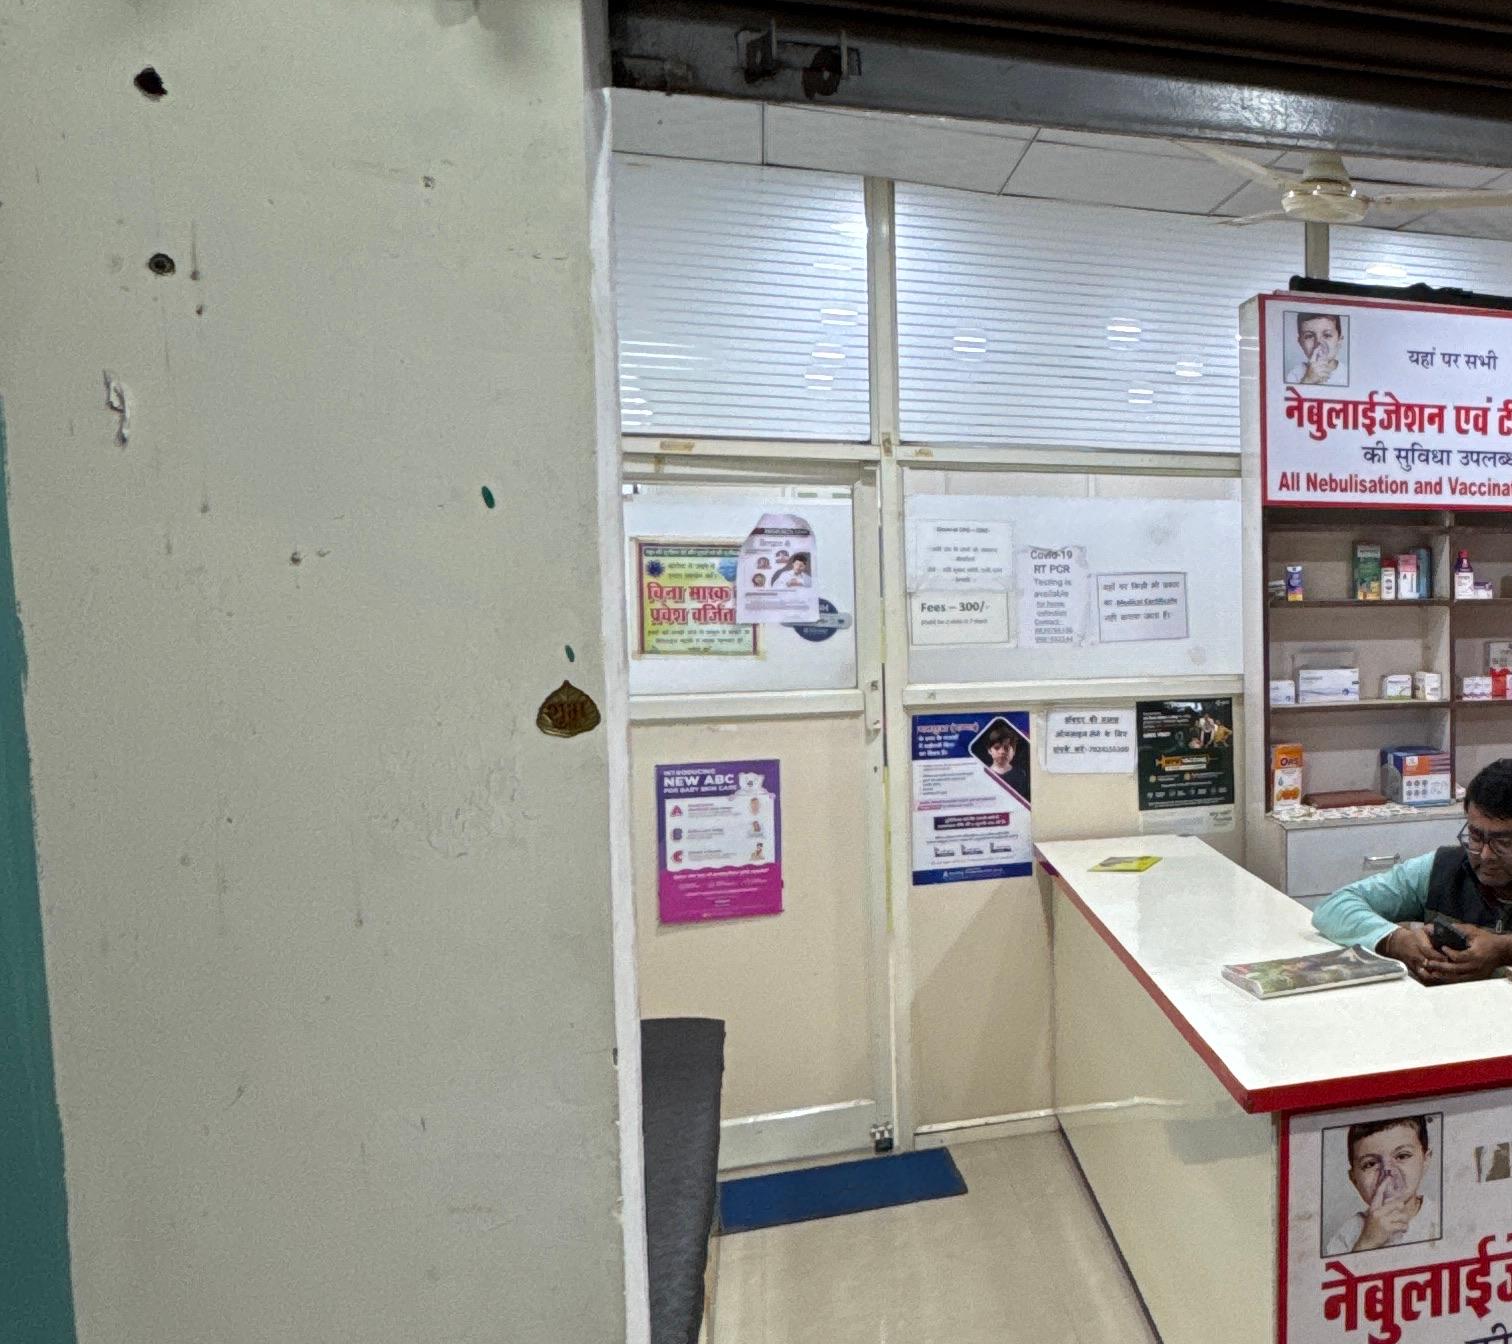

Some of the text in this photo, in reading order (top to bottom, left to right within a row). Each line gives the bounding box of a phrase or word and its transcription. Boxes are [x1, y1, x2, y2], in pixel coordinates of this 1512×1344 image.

[1407, 346, 1499, 371] यहां पर सभी
[1283, 385, 1447, 442] नेबुलाईजेशन
[1453, 396, 1493, 436] एवं
[1360, 440, 1388, 464] की
[1393, 442, 1453, 472] सुविधा
[1278, 471, 1301, 492] All
[1306, 472, 1409, 495] Nebulisation
[1414, 476, 1443, 496] and
[1033, 564, 1071, 574] RT PCR
[920, 602, 946, 613] Fees
[663, 774, 735, 787] NEW ABC
